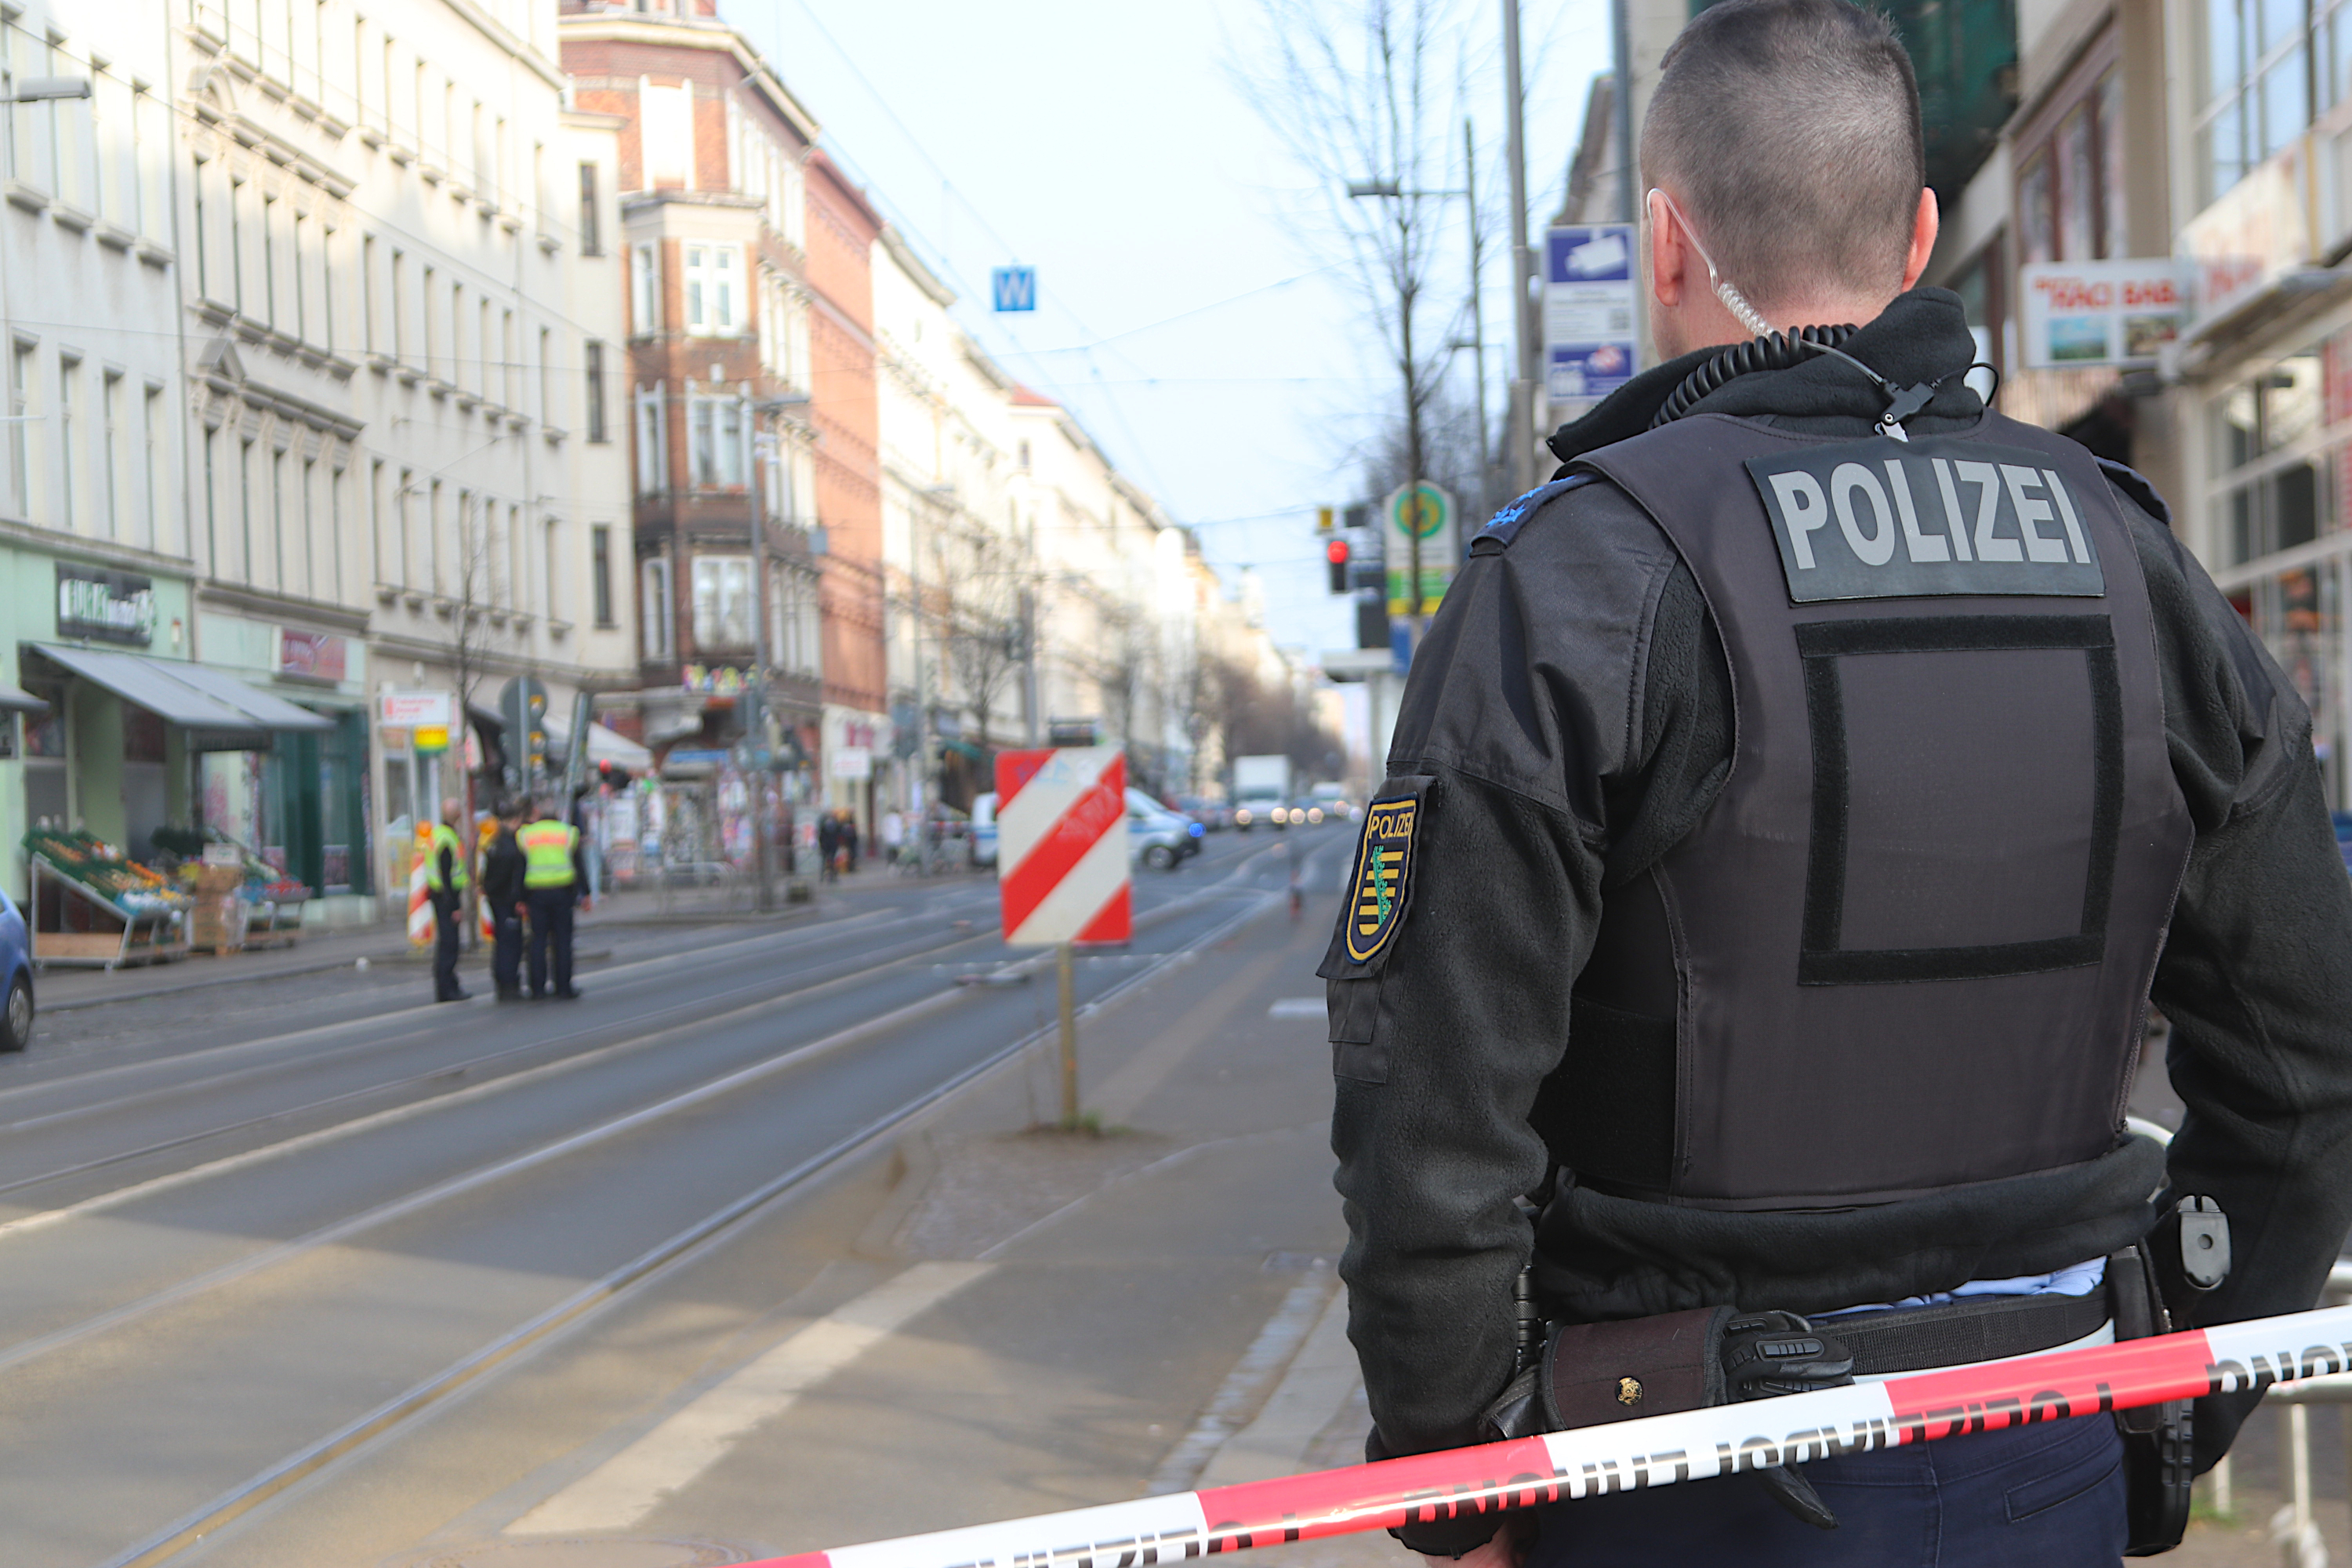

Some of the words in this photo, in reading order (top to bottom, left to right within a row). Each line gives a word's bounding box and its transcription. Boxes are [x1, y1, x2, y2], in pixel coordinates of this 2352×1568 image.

[996, 271, 1033, 305] W
[1768, 458, 2092, 570] POLIZEI
[1368, 811, 1414, 839] POLIZEI
